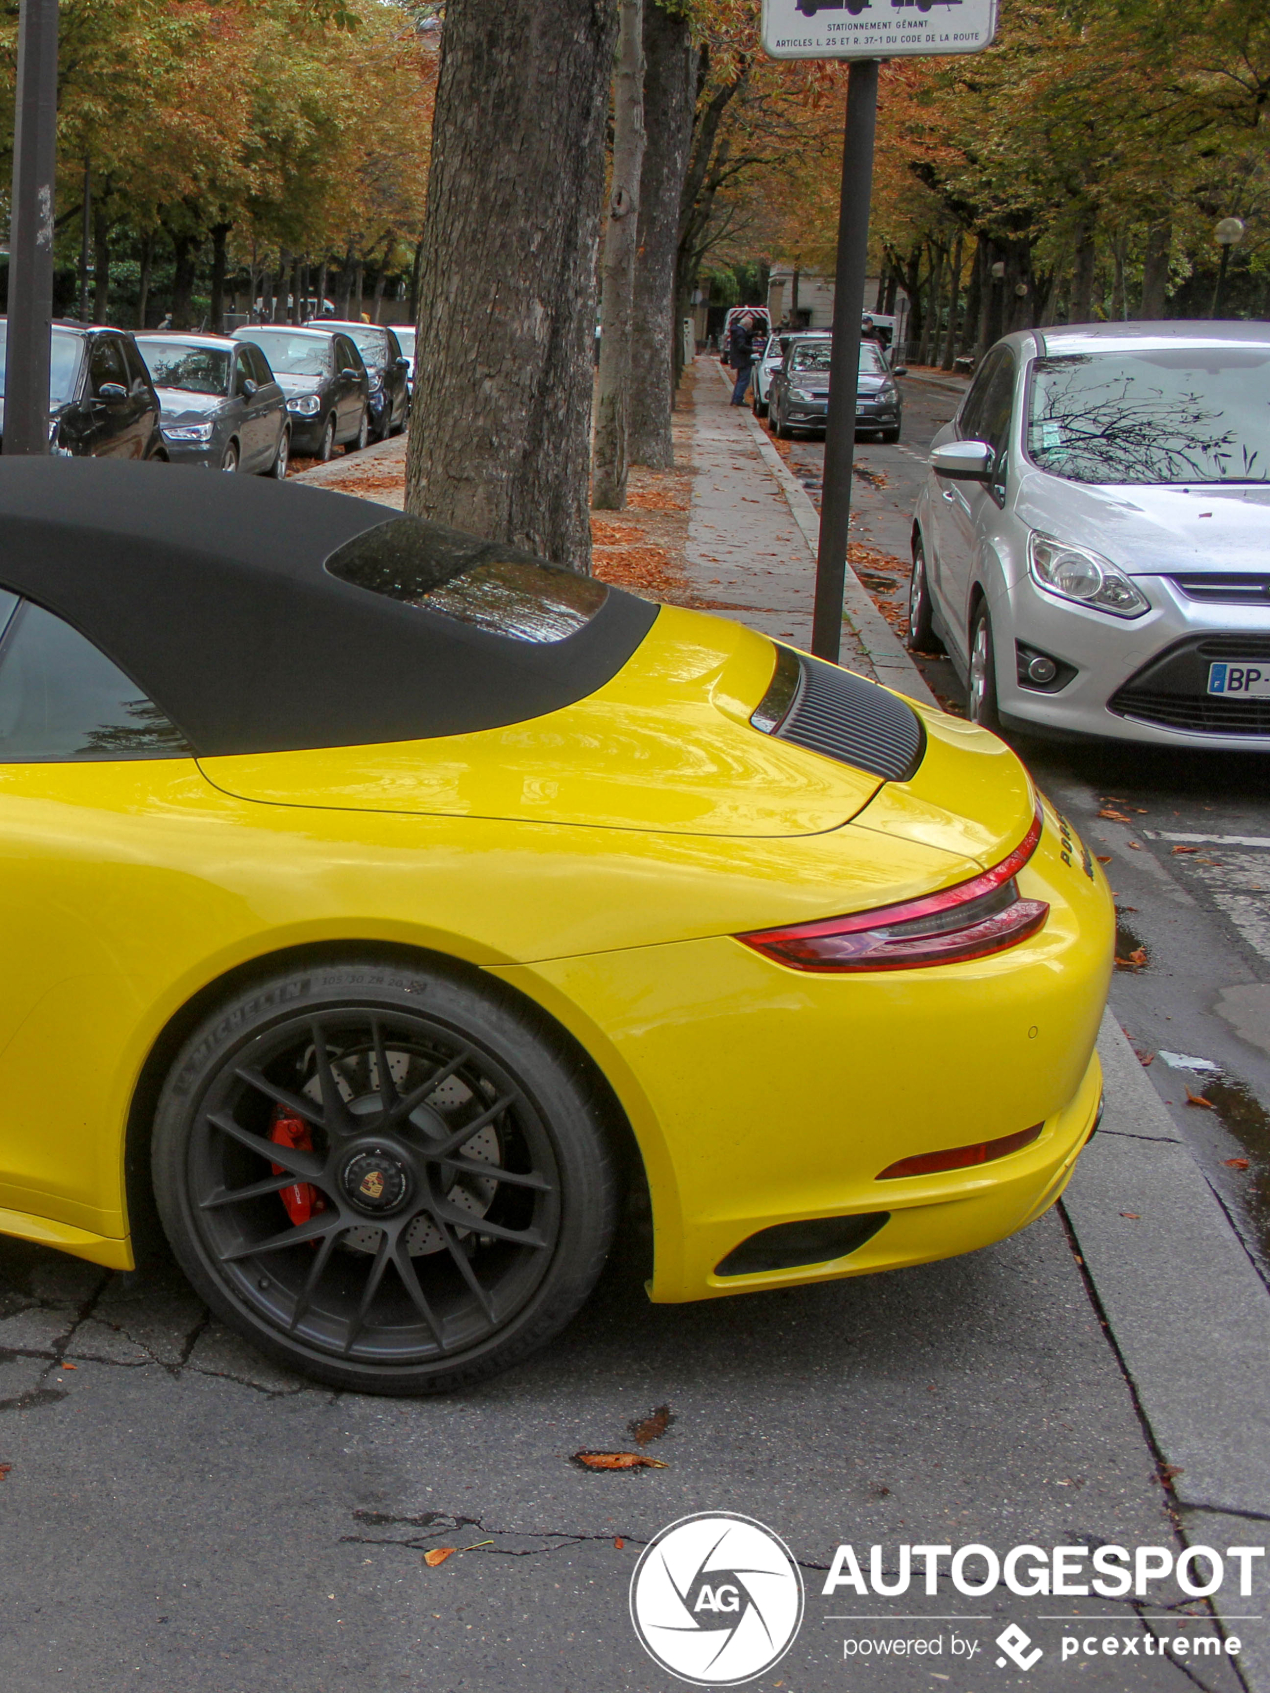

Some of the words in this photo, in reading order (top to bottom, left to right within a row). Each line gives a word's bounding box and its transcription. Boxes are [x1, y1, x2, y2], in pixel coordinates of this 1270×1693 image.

[827, 21, 892, 31] STATIONNEMENT
[895, 19, 929, 29] GÊNANT
[775, 38, 813, 47] ARTICLES
[816, 38, 823, 46] L.
[825, 37, 837, 46] 25
[840, 37, 849, 45] ET
[853, 37, 861, 45] R.
[886, 35, 897, 43] DU
[900, 34, 922, 43] CODE
[925, 34, 936, 42] DE
[939, 33, 949, 41] LA
[953, 32, 980, 41] ROUTE
[368, 975, 384, 985] ZR
[192, 980, 302, 1063] MICHELIN
